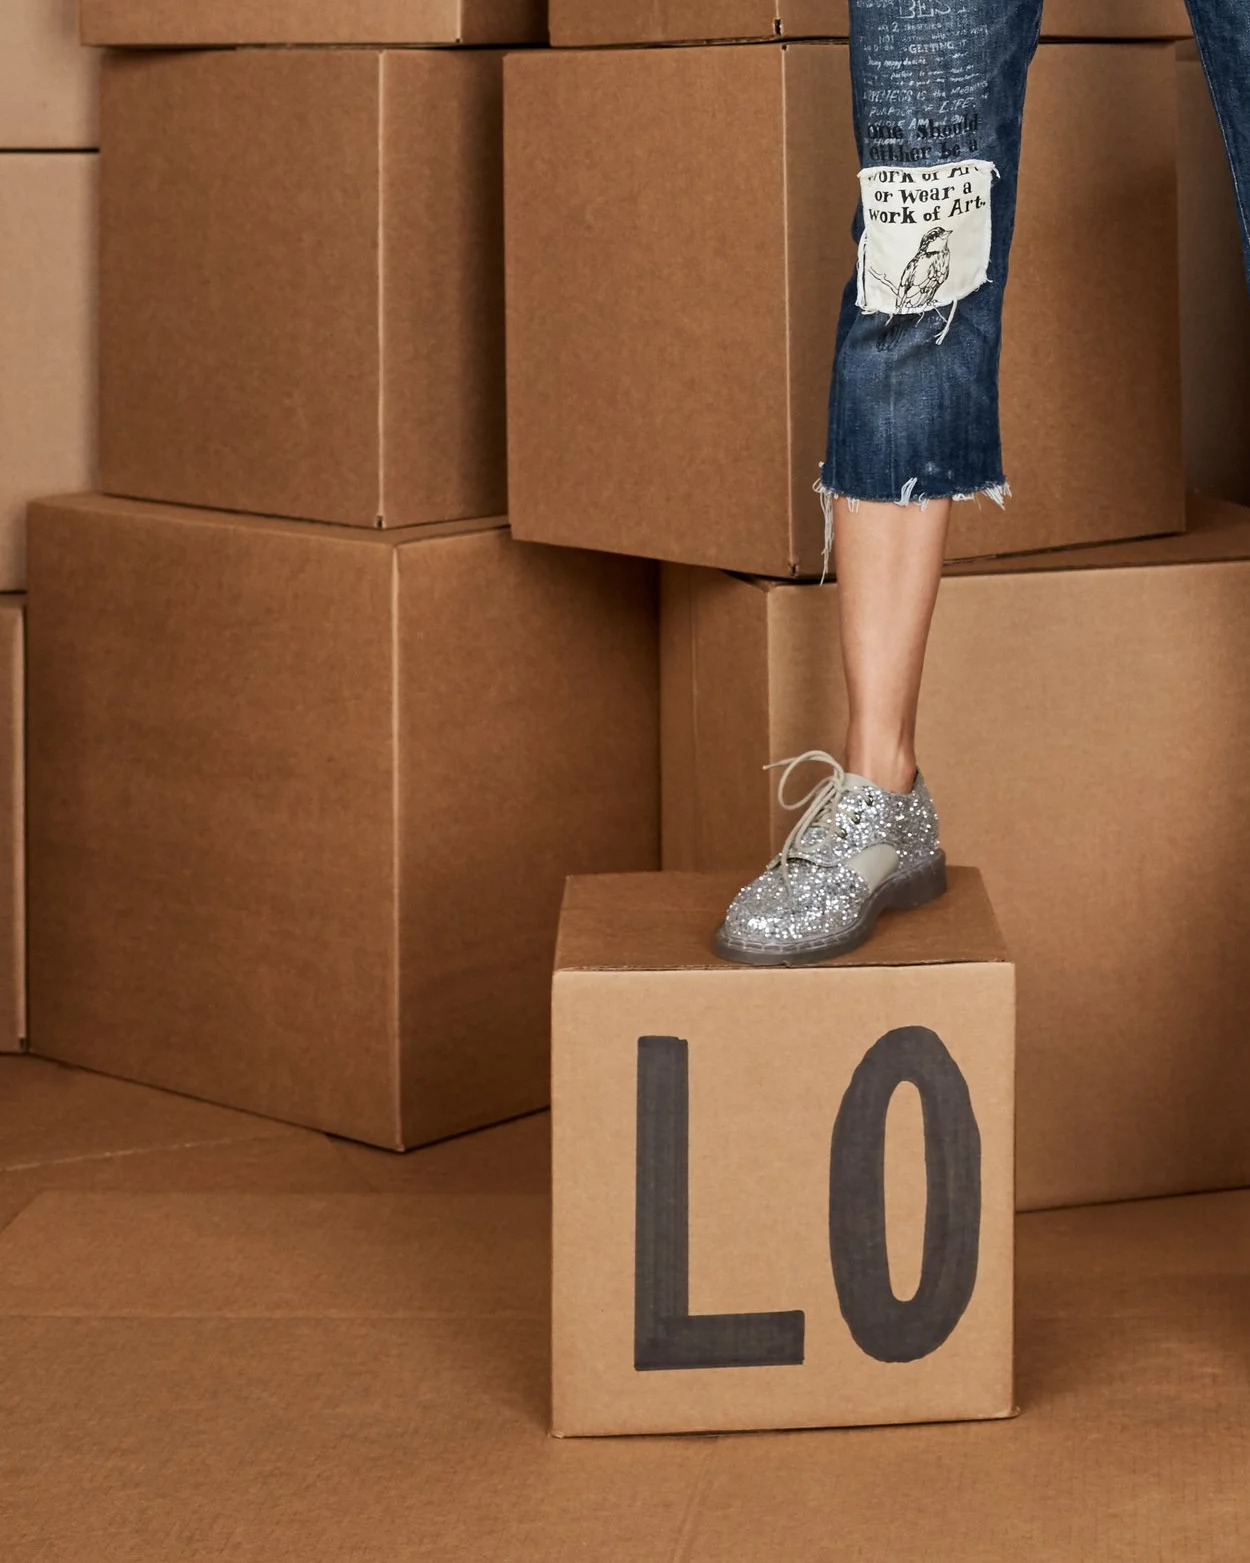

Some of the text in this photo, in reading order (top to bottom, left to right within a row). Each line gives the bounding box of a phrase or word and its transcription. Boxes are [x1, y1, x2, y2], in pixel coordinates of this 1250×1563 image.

[908, 40, 955, 54] GETTING
[867, 123, 904, 140] one
[916, 111, 979, 139] should
[940, 141, 962, 160] be
[967, 138, 980, 154] a
[875, 190, 894, 203] or
[963, 181, 972, 195] a
[923, 205, 941, 222] of
